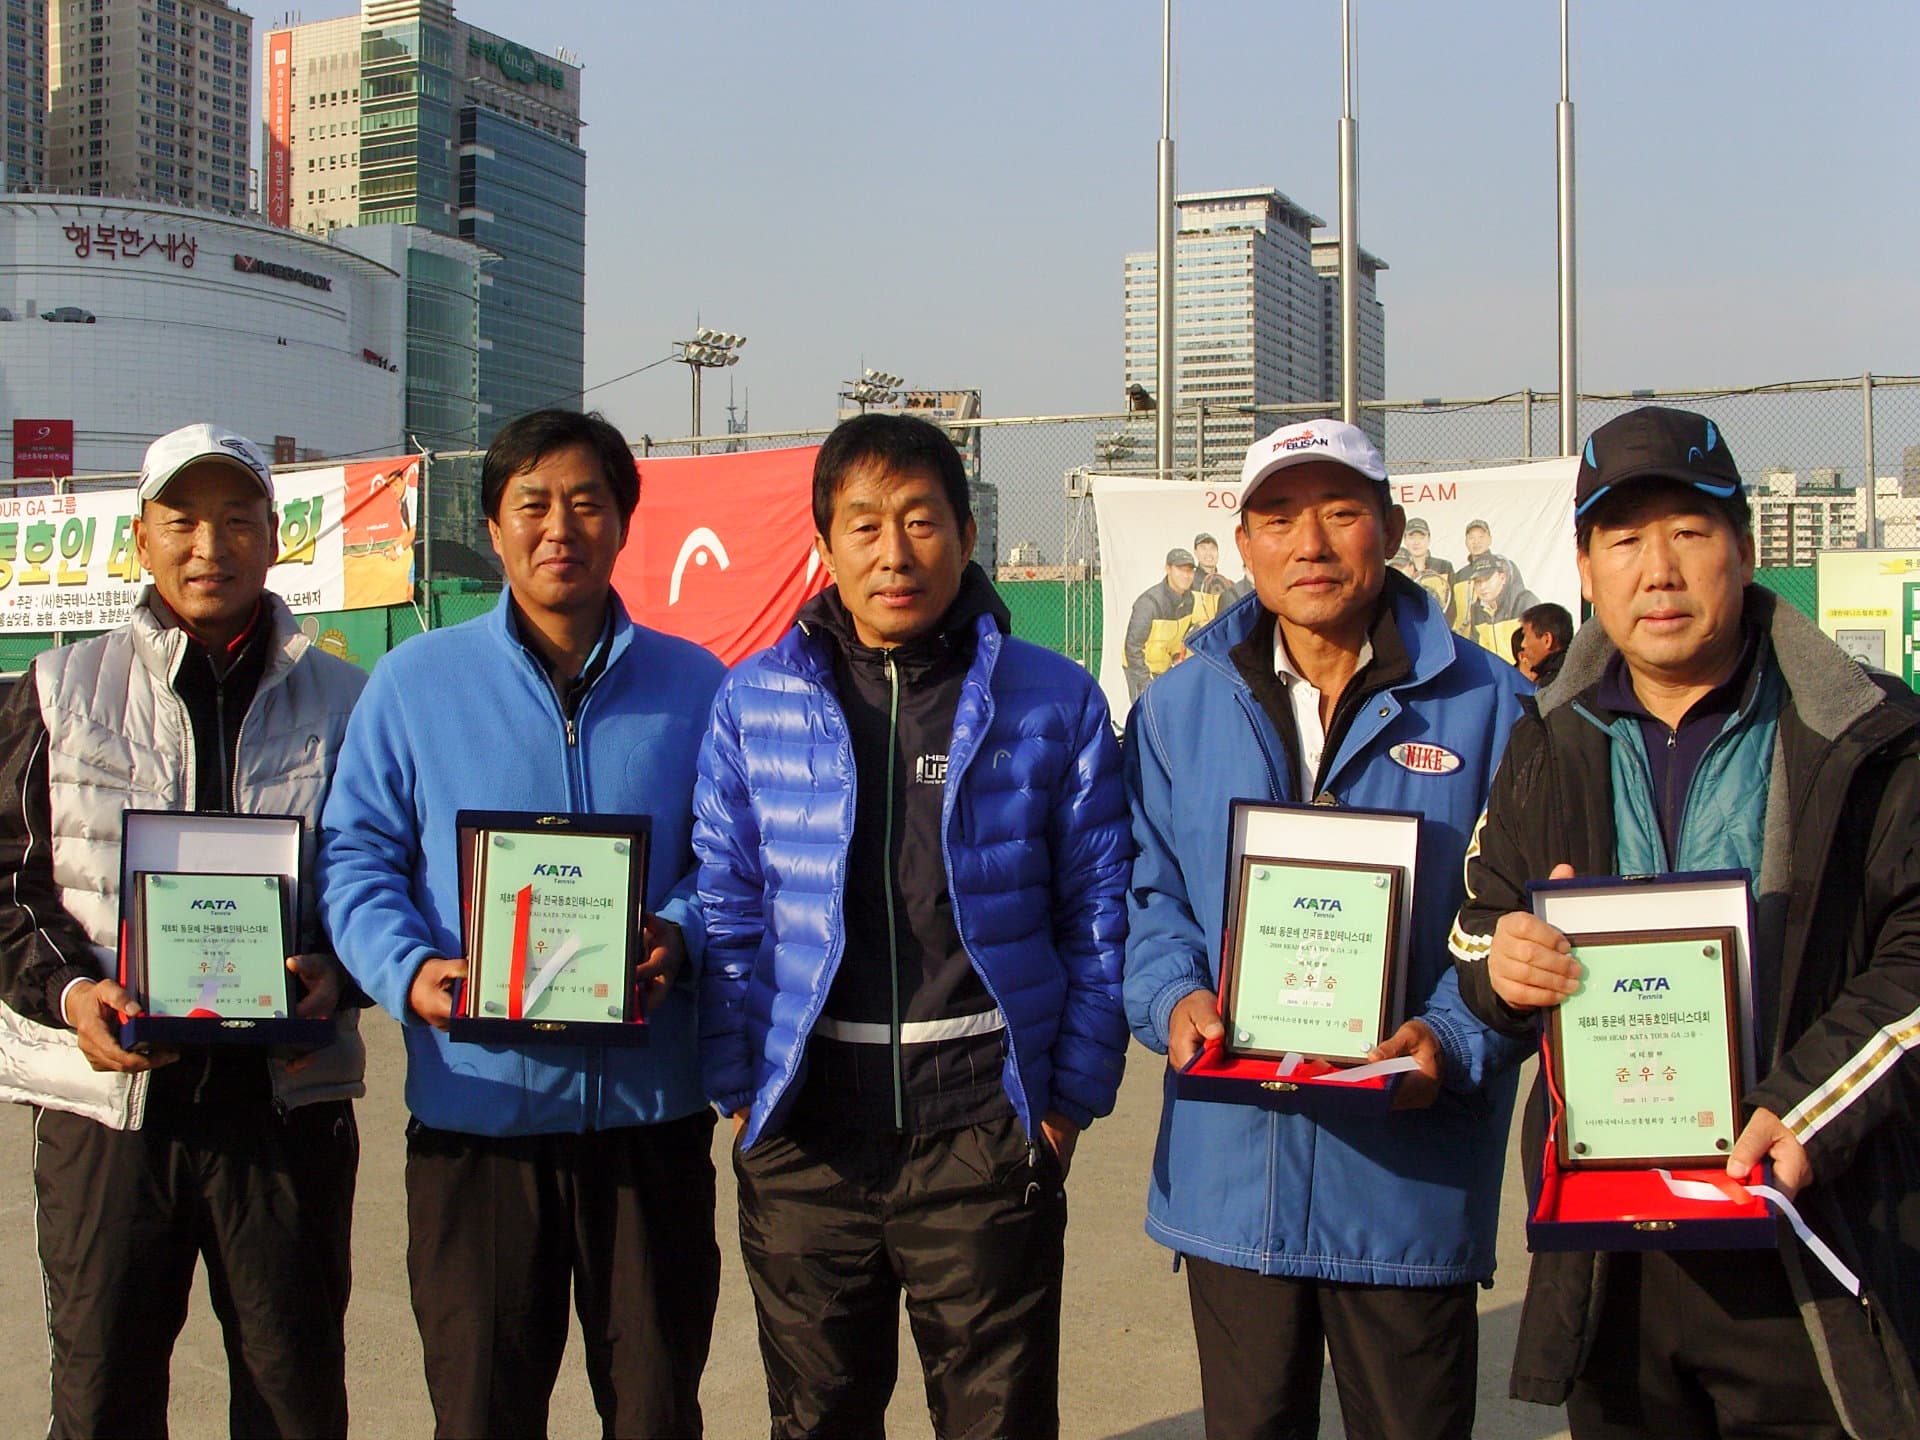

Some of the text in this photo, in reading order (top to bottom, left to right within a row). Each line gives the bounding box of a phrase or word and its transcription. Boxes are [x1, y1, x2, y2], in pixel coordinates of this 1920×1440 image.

[62, 222, 198, 268] 행복한세상
[1287, 437, 1328, 450] BUSAN
[1391, 482, 1456, 503] EAM
[26, 500, 46, 516] GA
[52, 496, 77, 515] 그룹
[17, 595, 32, 609] 주관
[1406, 745, 1443, 770] NIKE
[533, 864, 583, 878] KATA
[191, 900, 237, 910] KATA
[1293, 897, 1342, 912] KATA
[1613, 977, 1670, 992] KATA
[1628, 1010, 1710, 1027] 전국동호인테니스대회
